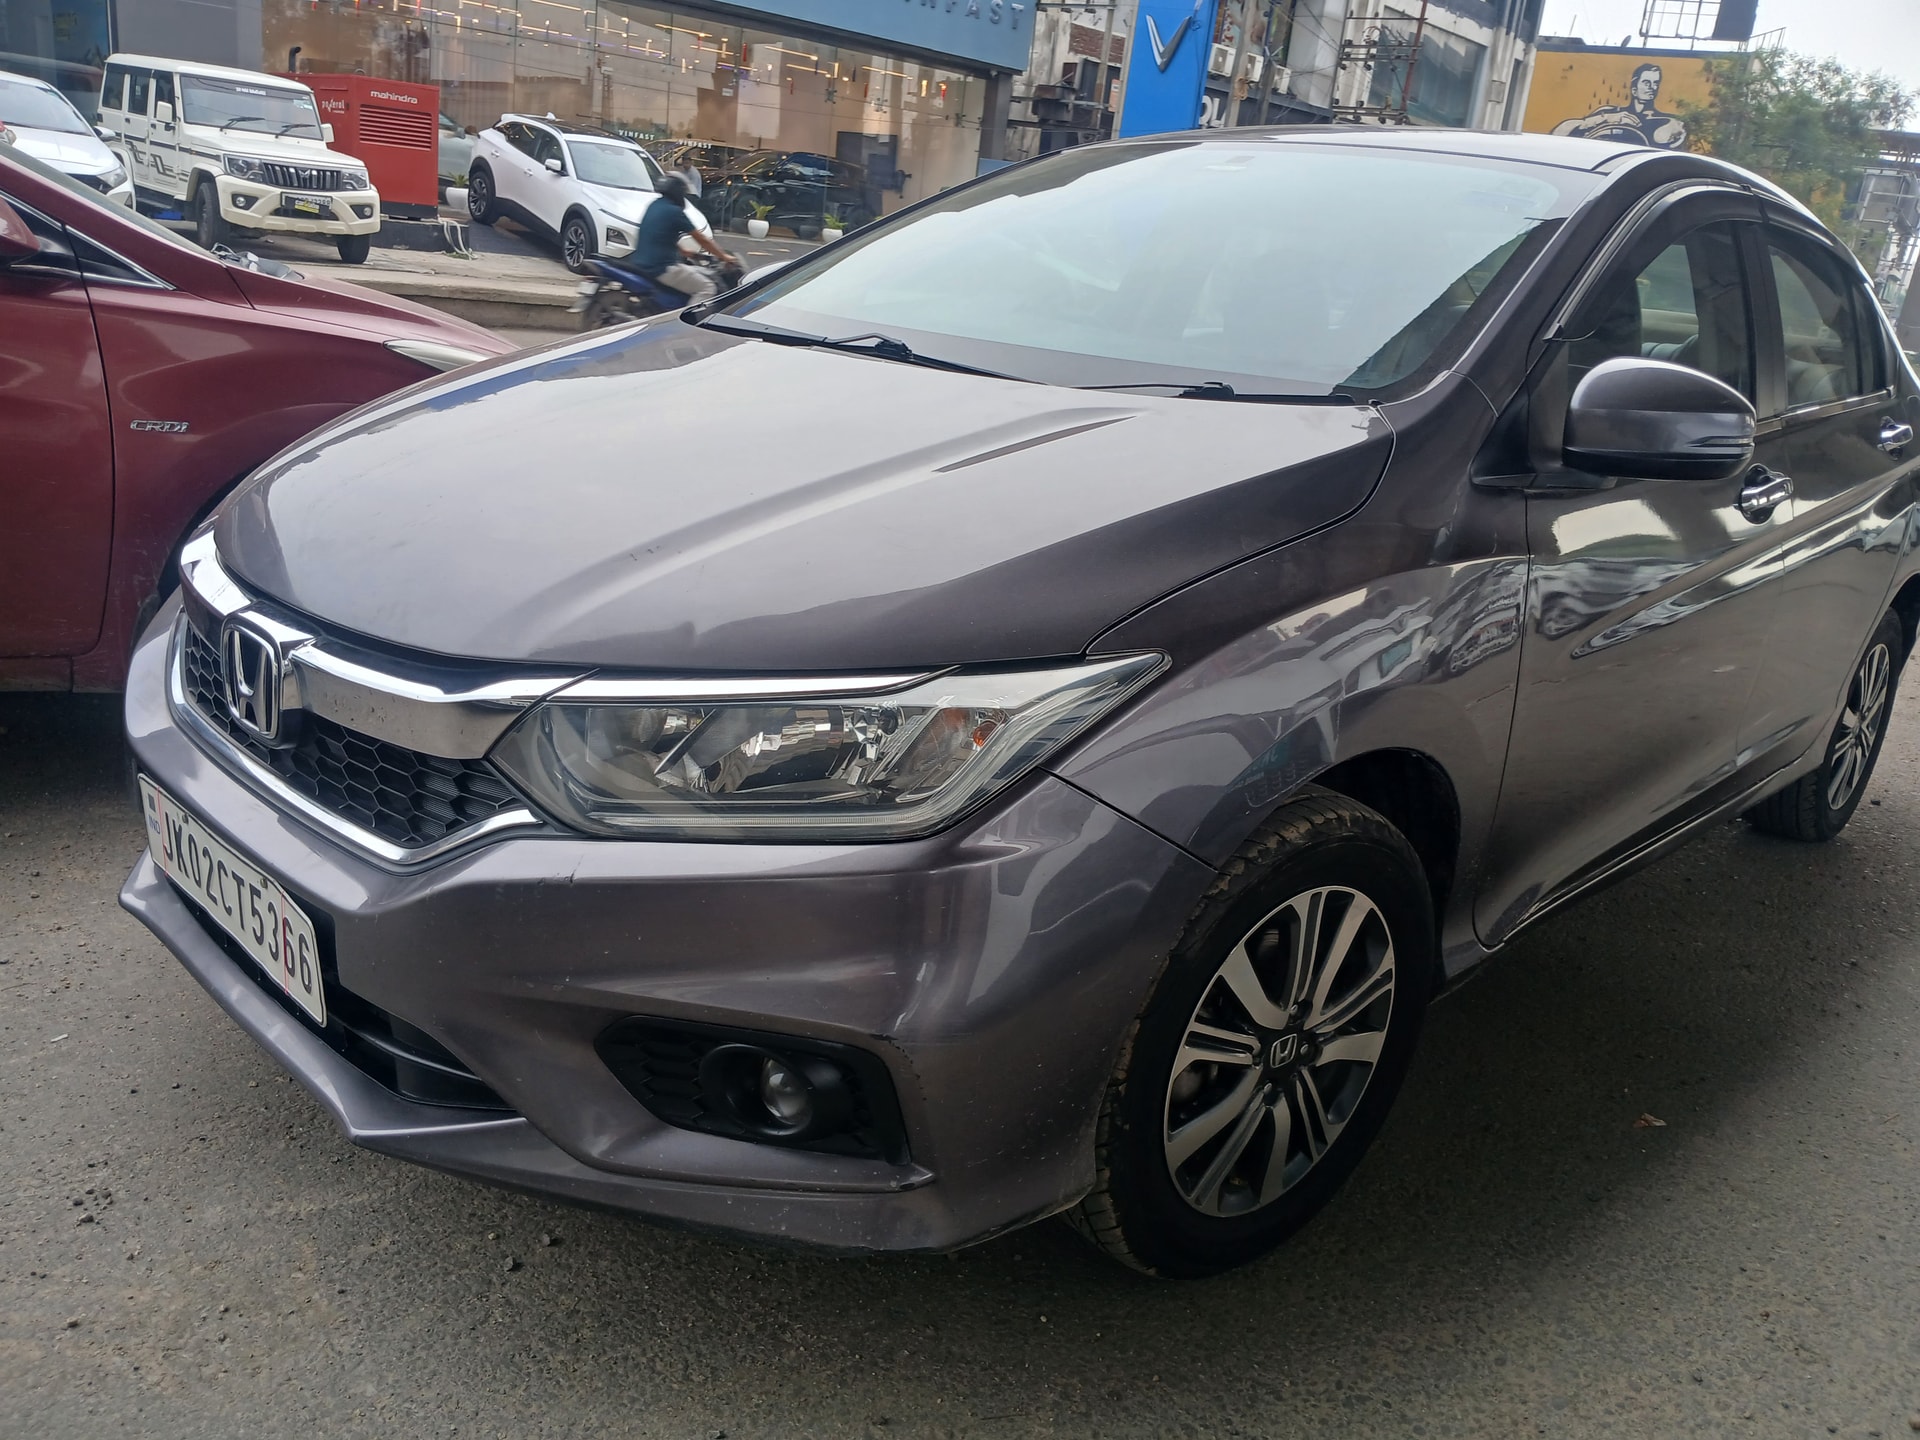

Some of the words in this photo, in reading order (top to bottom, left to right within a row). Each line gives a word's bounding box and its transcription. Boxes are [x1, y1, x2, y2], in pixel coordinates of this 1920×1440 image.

[370, 90, 418, 104] mahindra
[618, 129, 655, 141] VINFAST
[163, 810, 313, 996] JK02CT5366
